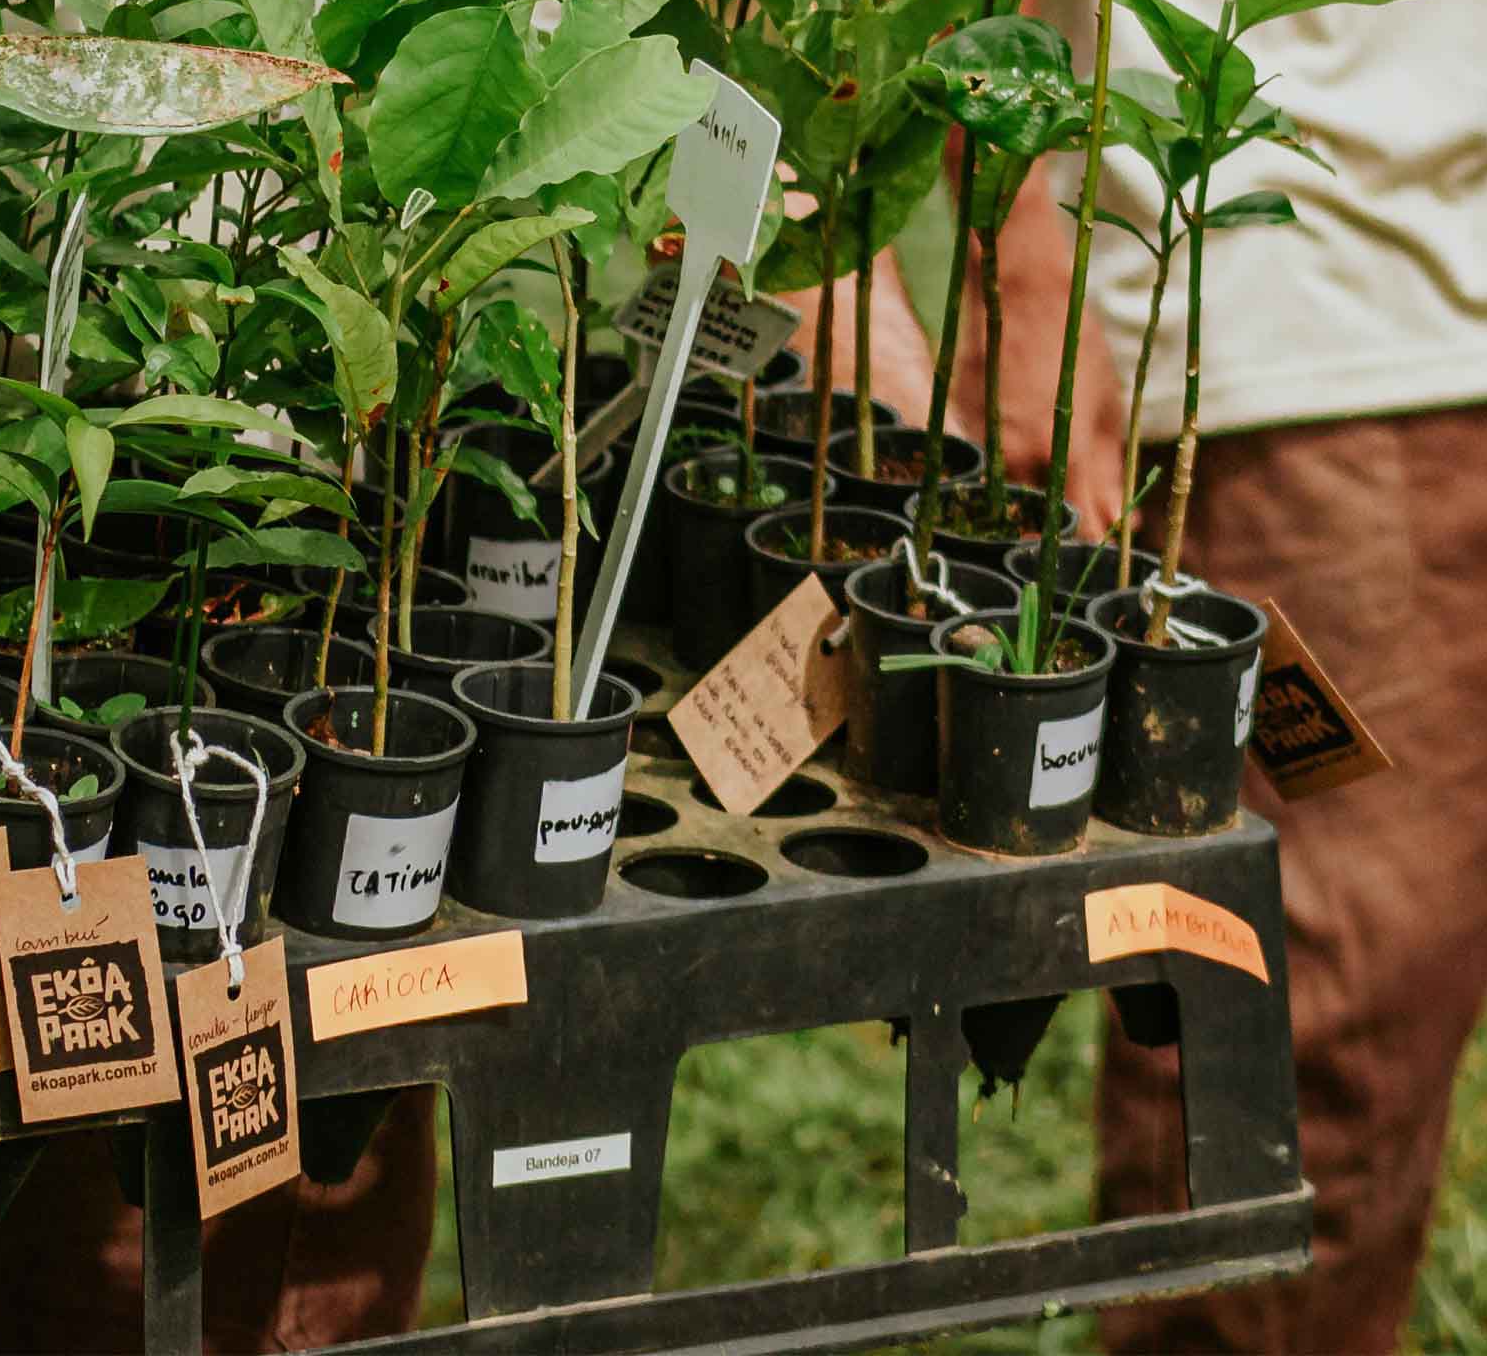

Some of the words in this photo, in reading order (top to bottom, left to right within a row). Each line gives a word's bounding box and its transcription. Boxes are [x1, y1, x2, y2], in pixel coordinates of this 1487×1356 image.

[469, 558, 555, 588] araribá
[31, 957, 133, 1015] EKÔA
[37, 1003, 142, 1056] PARK
[31, 1060, 158, 1092] ekoapark.com.br
[208, 1044, 277, 1109] EKÔA
[212, 1084, 281, 1149] PARK
[207, 1140, 290, 1187] ekoapark.com.br
[525, 1153, 580, 1172] Bandeja
[584, 1148, 602, 1163] 07
